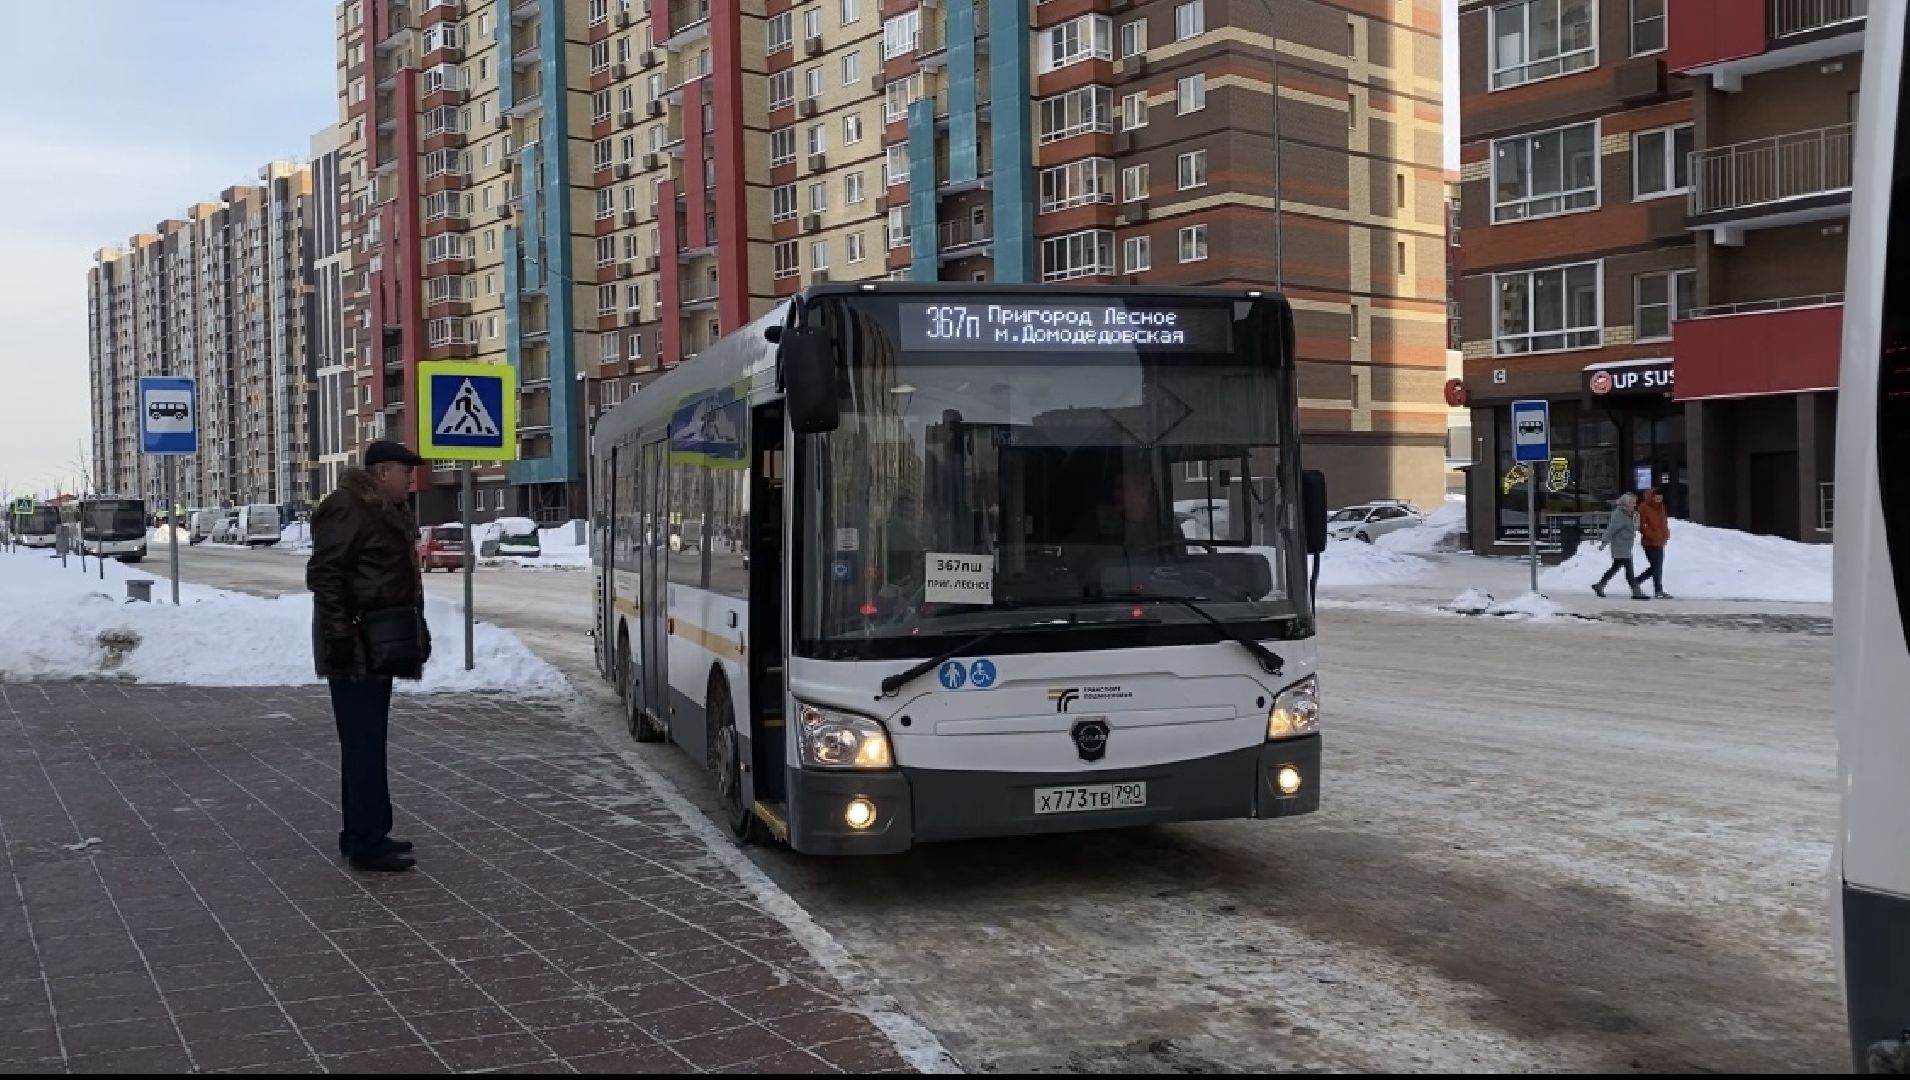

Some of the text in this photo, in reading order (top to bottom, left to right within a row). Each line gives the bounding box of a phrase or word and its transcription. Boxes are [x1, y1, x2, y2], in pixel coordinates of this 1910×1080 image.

[925, 305, 1178, 338] 367п Пригород Лесное
[995, 325, 1184, 345] м.Домодедовская
[1613, 373, 1638, 389] UP
